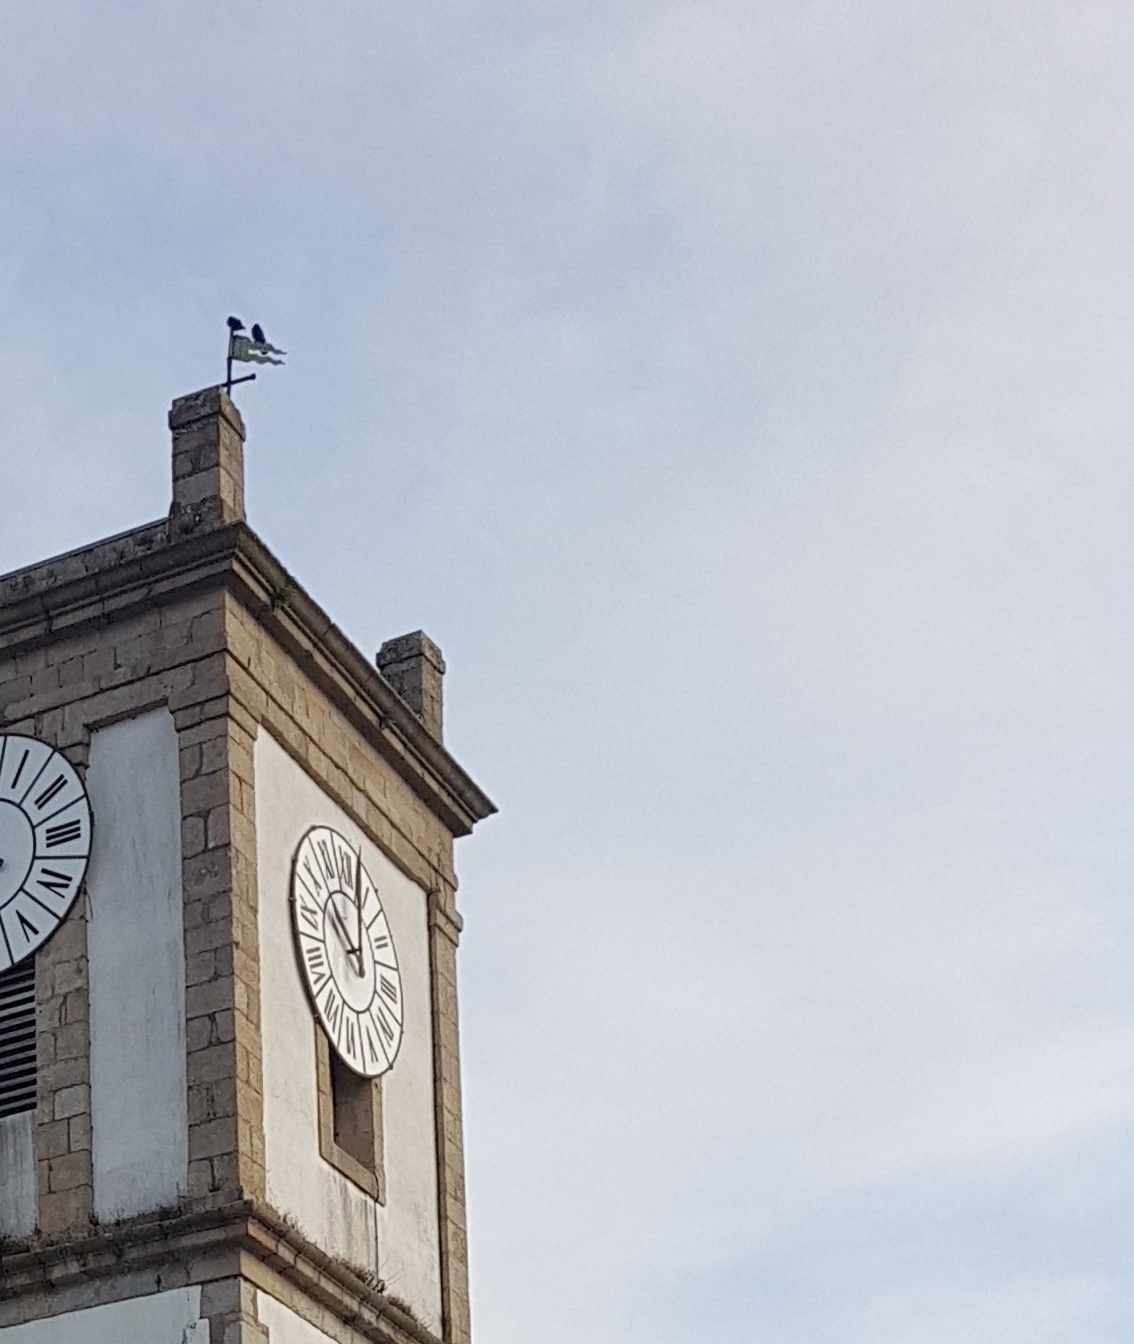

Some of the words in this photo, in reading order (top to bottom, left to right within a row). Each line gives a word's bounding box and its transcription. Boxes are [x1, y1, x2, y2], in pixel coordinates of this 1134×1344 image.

[11, 749, 30, 789] I
[34, 774, 67, 810] II
[46, 819, 81, 848] III
[303, 855, 322, 897] X
[317, 839, 335, 880] XI
[338, 845, 354, 891] XII
[36, 868, 73, 899] IV
[16, 909, 39, 943] V
[299, 894, 318, 931] IX
[374, 935, 389, 950] II
[306, 946, 326, 985] VIII
[380, 973, 398, 1005] III
[324, 988, 340, 1034] VII
[376, 1006, 394, 1048] IV
[346, 1015, 357, 1060] VI
[366, 1025, 379, 1063] V
